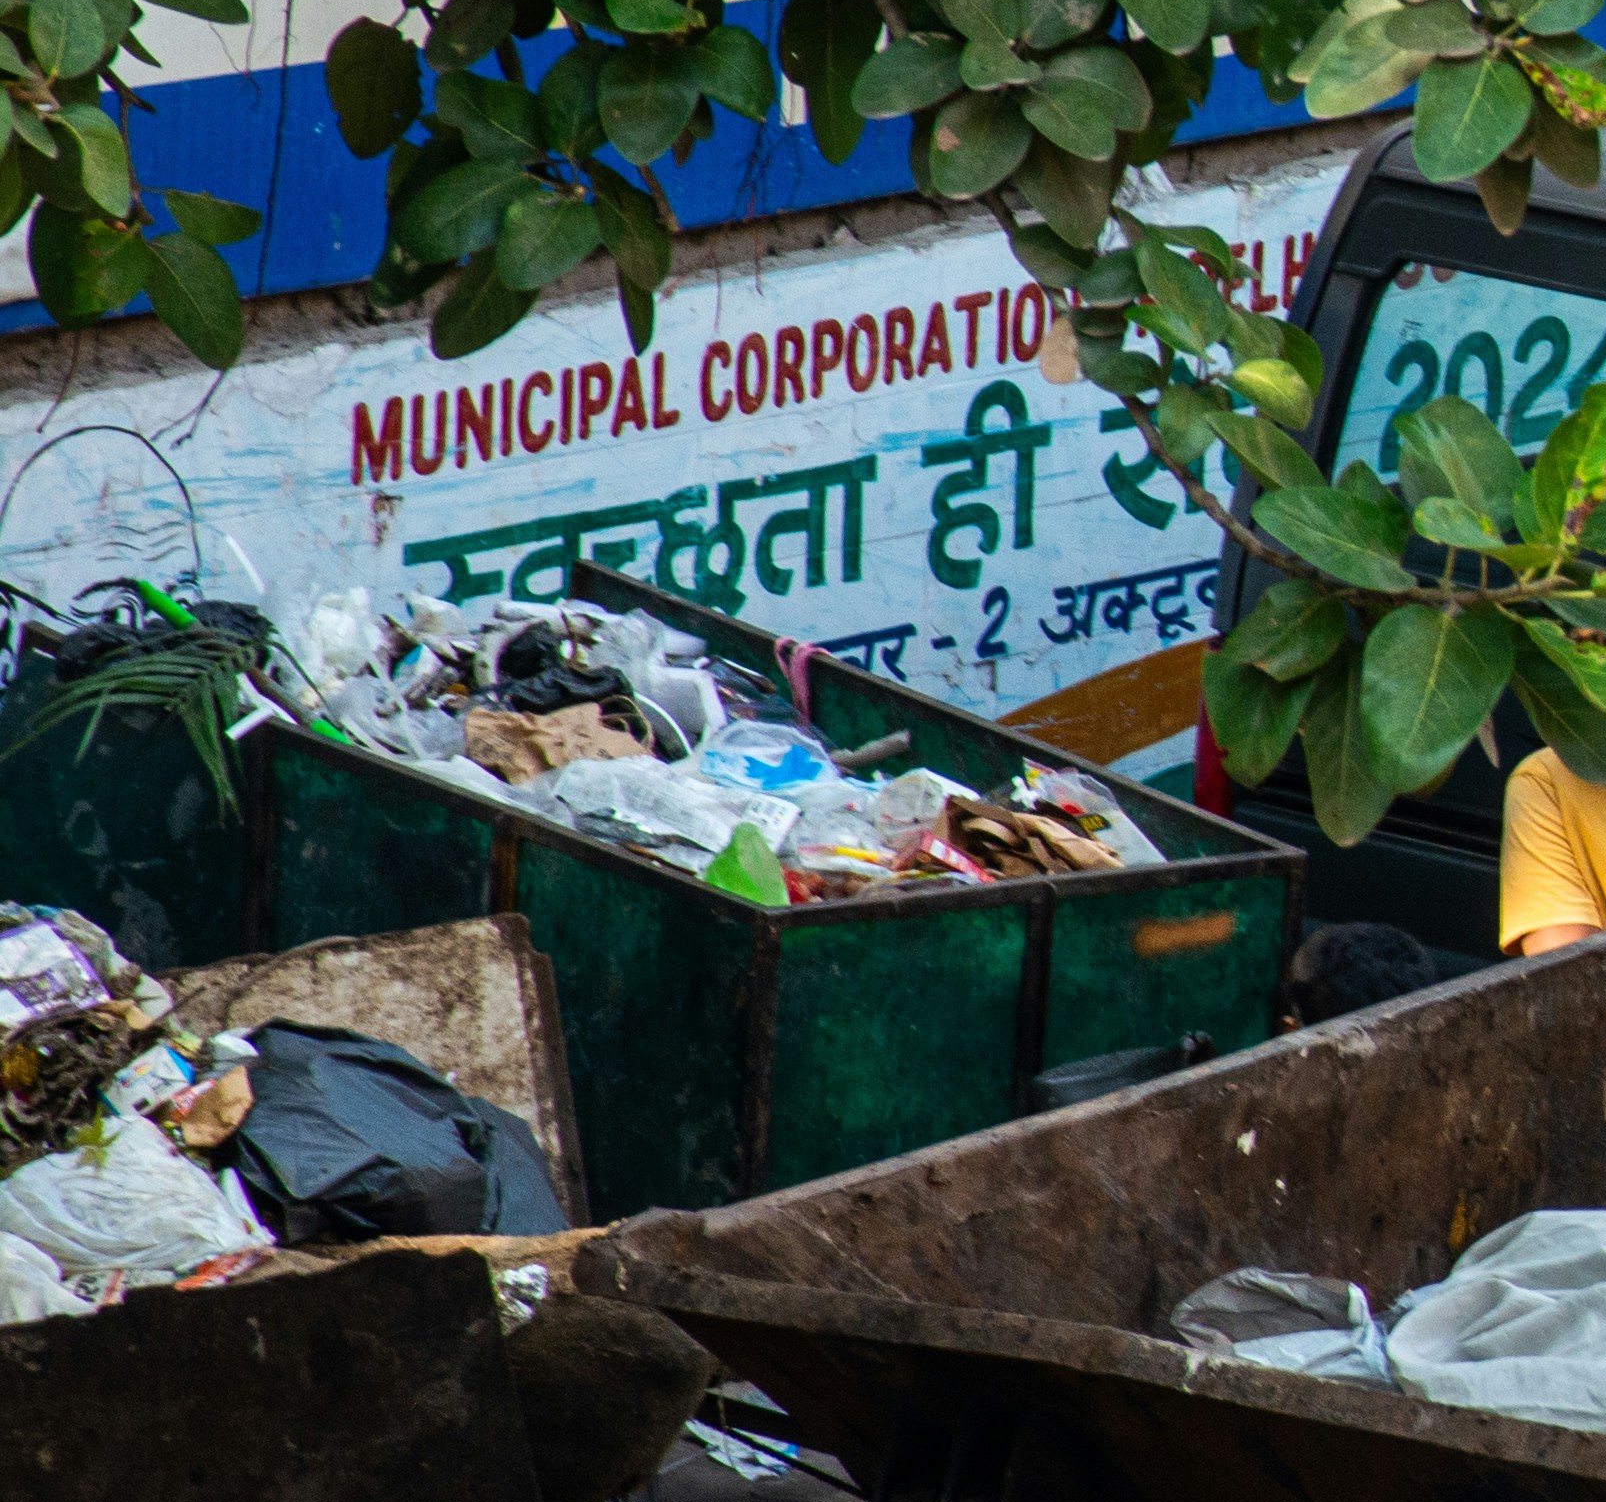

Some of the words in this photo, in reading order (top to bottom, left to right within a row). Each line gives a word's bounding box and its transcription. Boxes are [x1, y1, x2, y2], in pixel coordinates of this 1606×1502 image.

[351, 354, 681, 485] MUNICIPAL
[921, 379, 1052, 590] ही
[976, 585, 1011, 660] 2
